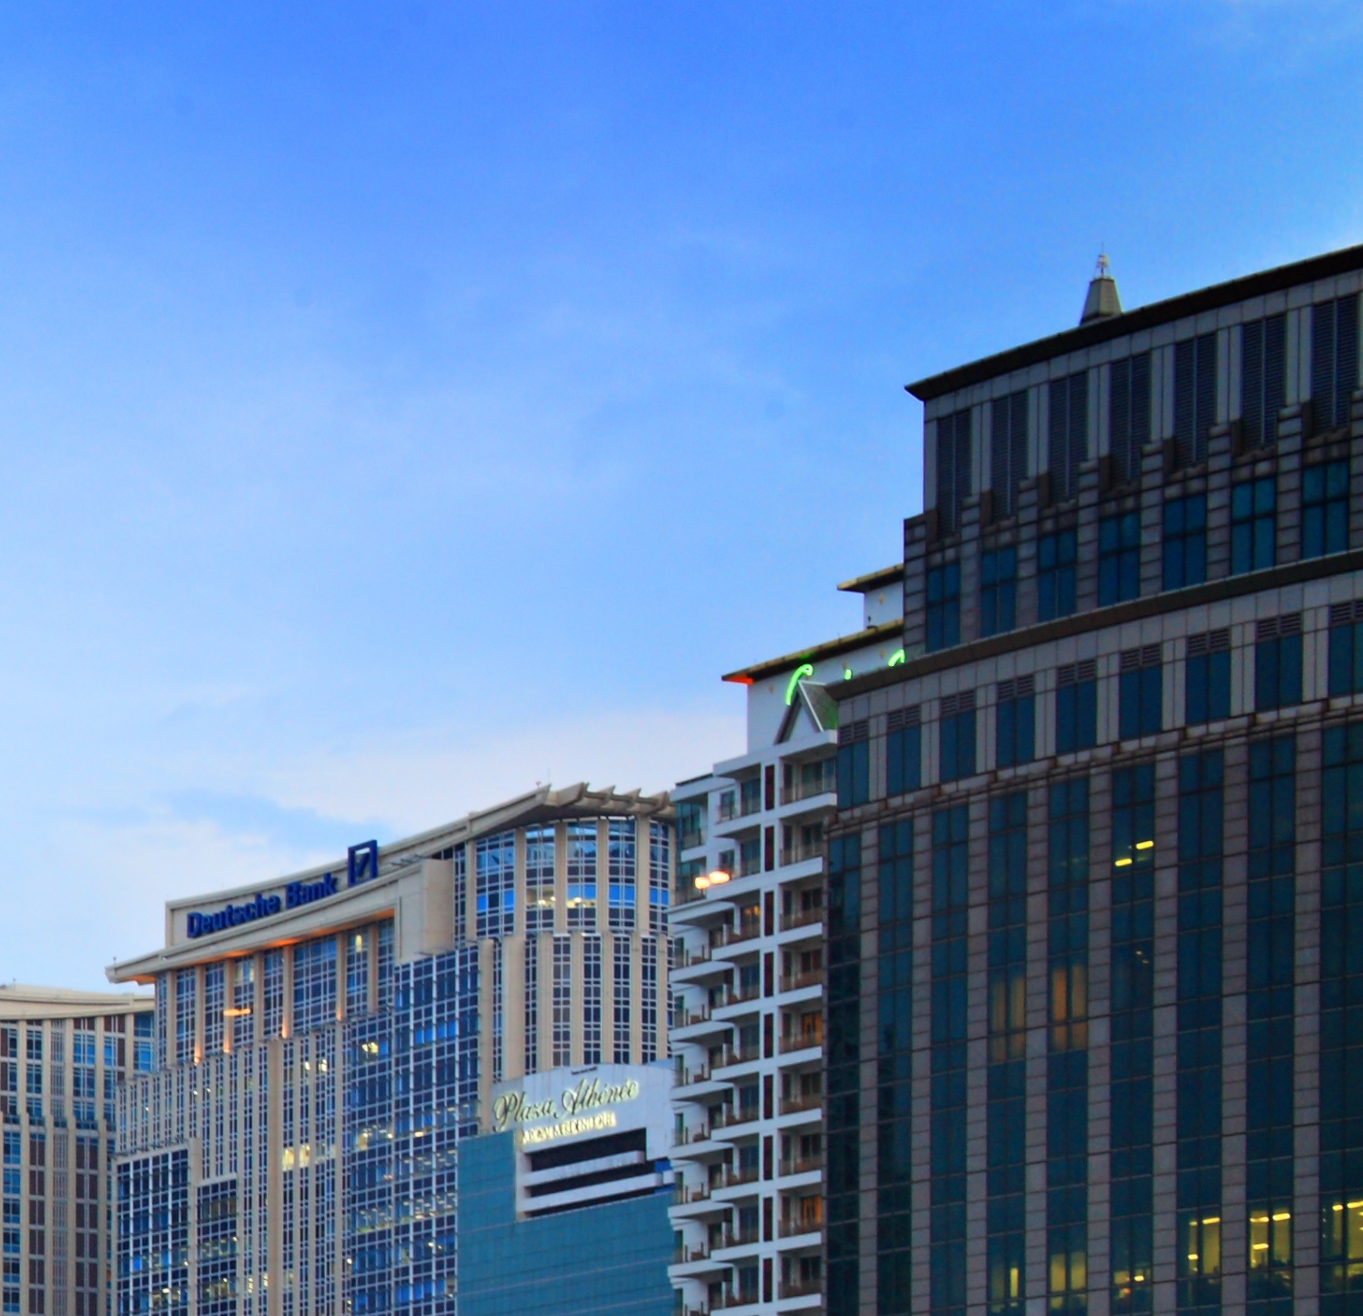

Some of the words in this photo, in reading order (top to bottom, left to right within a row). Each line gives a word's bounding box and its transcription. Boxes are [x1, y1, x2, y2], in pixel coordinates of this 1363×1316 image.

[186, 892, 281, 939] Deutsche
[284, 872, 339, 909] Bank
[492, 1089, 556, 1132] Plaza
